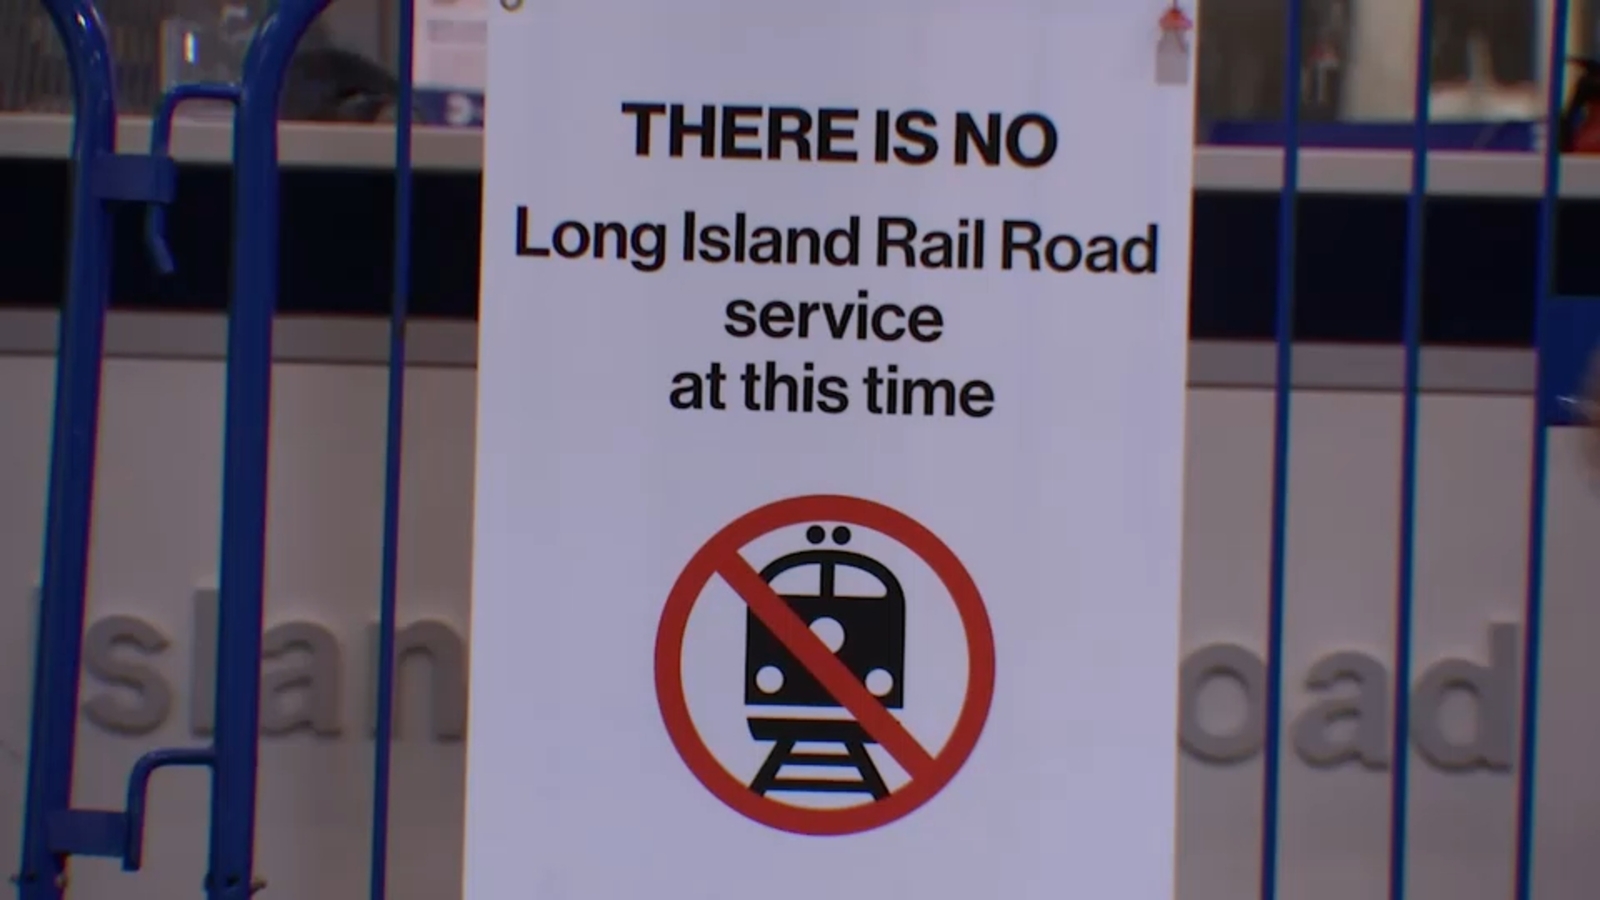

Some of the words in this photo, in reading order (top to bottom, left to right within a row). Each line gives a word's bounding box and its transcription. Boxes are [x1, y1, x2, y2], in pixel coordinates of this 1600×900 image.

[620, 101, 860, 164] THERE
[874, 108, 940, 166] IS
[953, 110, 1059, 169] NO
[515, 204, 667, 273] Long
[682, 209, 861, 268] Island
[876, 215, 986, 270] Rail
[1001, 218, 1159, 275] Road
[723, 288, 945, 344] service
[668, 361, 728, 411] at
[739, 361, 850, 415] this
[862, 365, 996, 419] time
